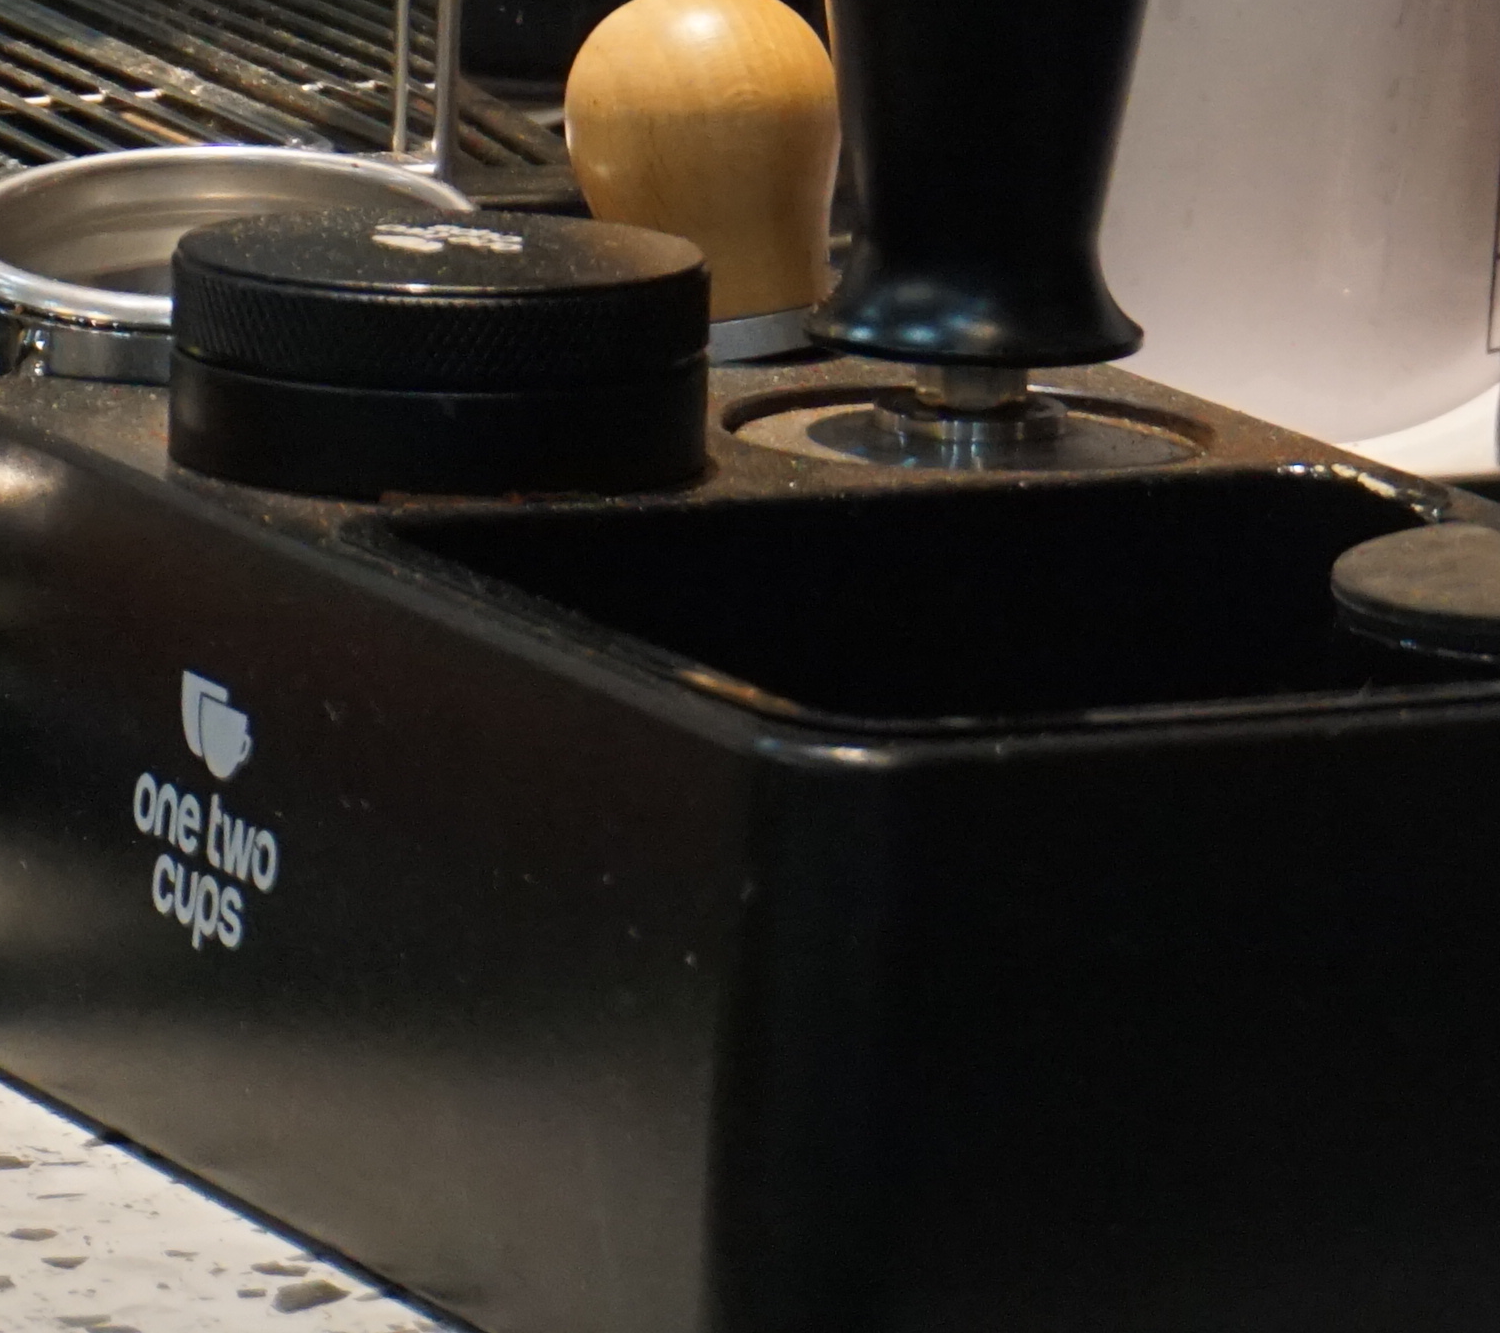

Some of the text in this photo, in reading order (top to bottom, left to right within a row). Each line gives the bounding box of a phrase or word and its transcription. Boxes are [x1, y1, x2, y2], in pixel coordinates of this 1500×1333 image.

[133, 772, 277, 895] one two
[152, 854, 243, 950] cups
